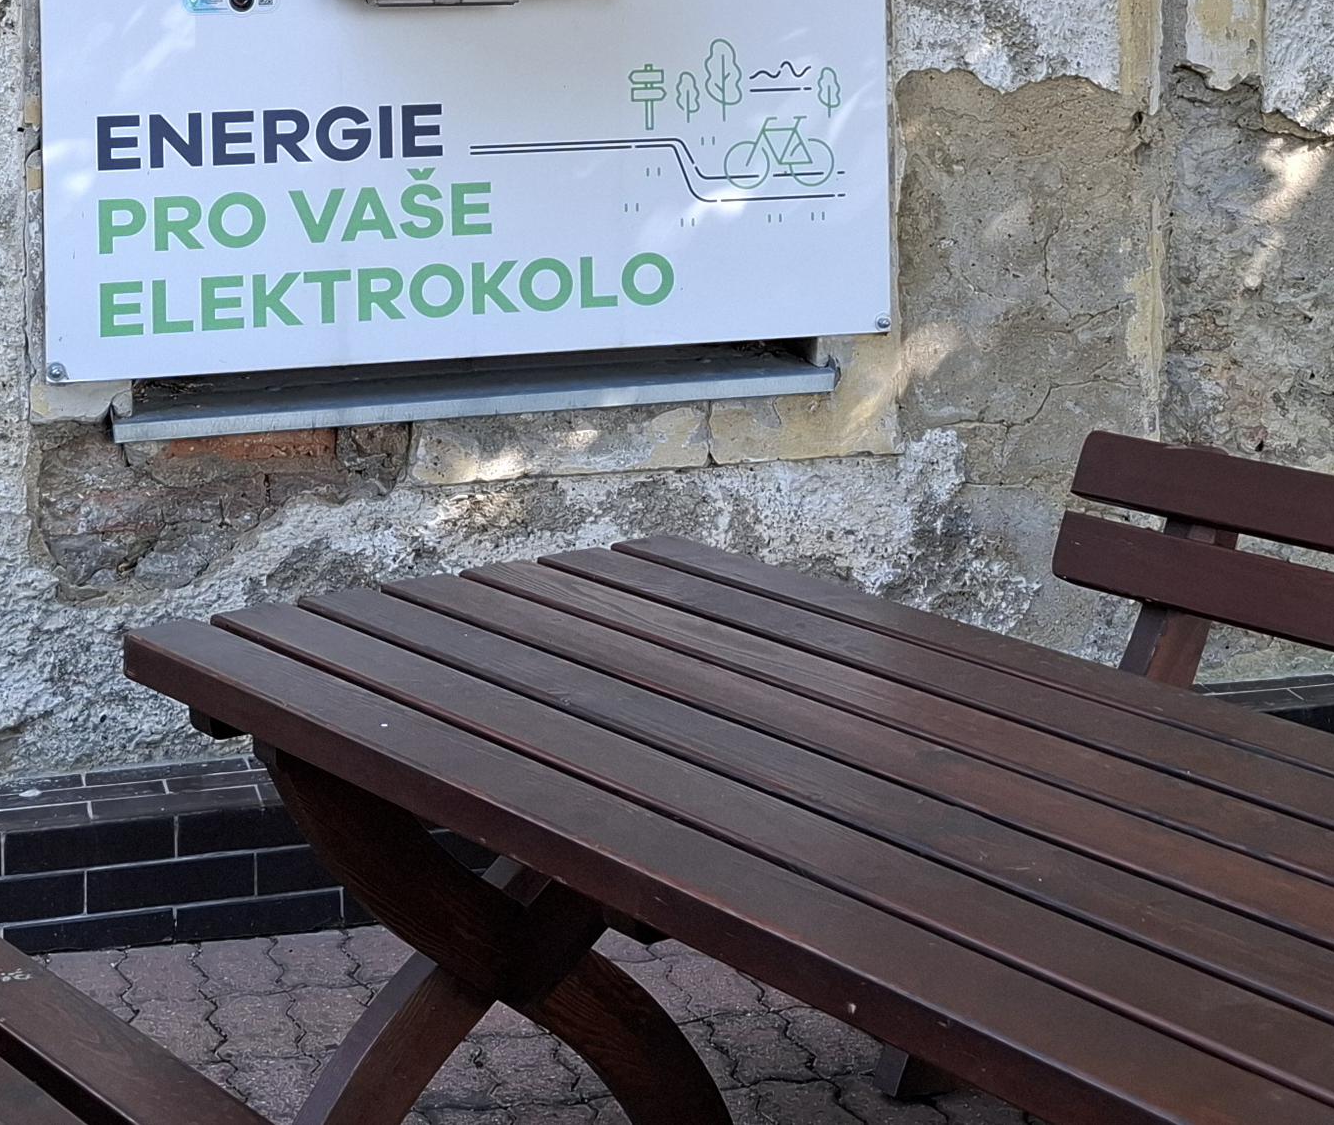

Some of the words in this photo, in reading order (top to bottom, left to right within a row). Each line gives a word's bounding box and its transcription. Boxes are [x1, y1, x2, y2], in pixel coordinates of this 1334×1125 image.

[96, 103, 444, 171] ENERGIE
[97, 192, 266, 255] PRO
[288, 168, 493, 243] VAŠE
[98, 252, 674, 337] ELEKTROKOLO
